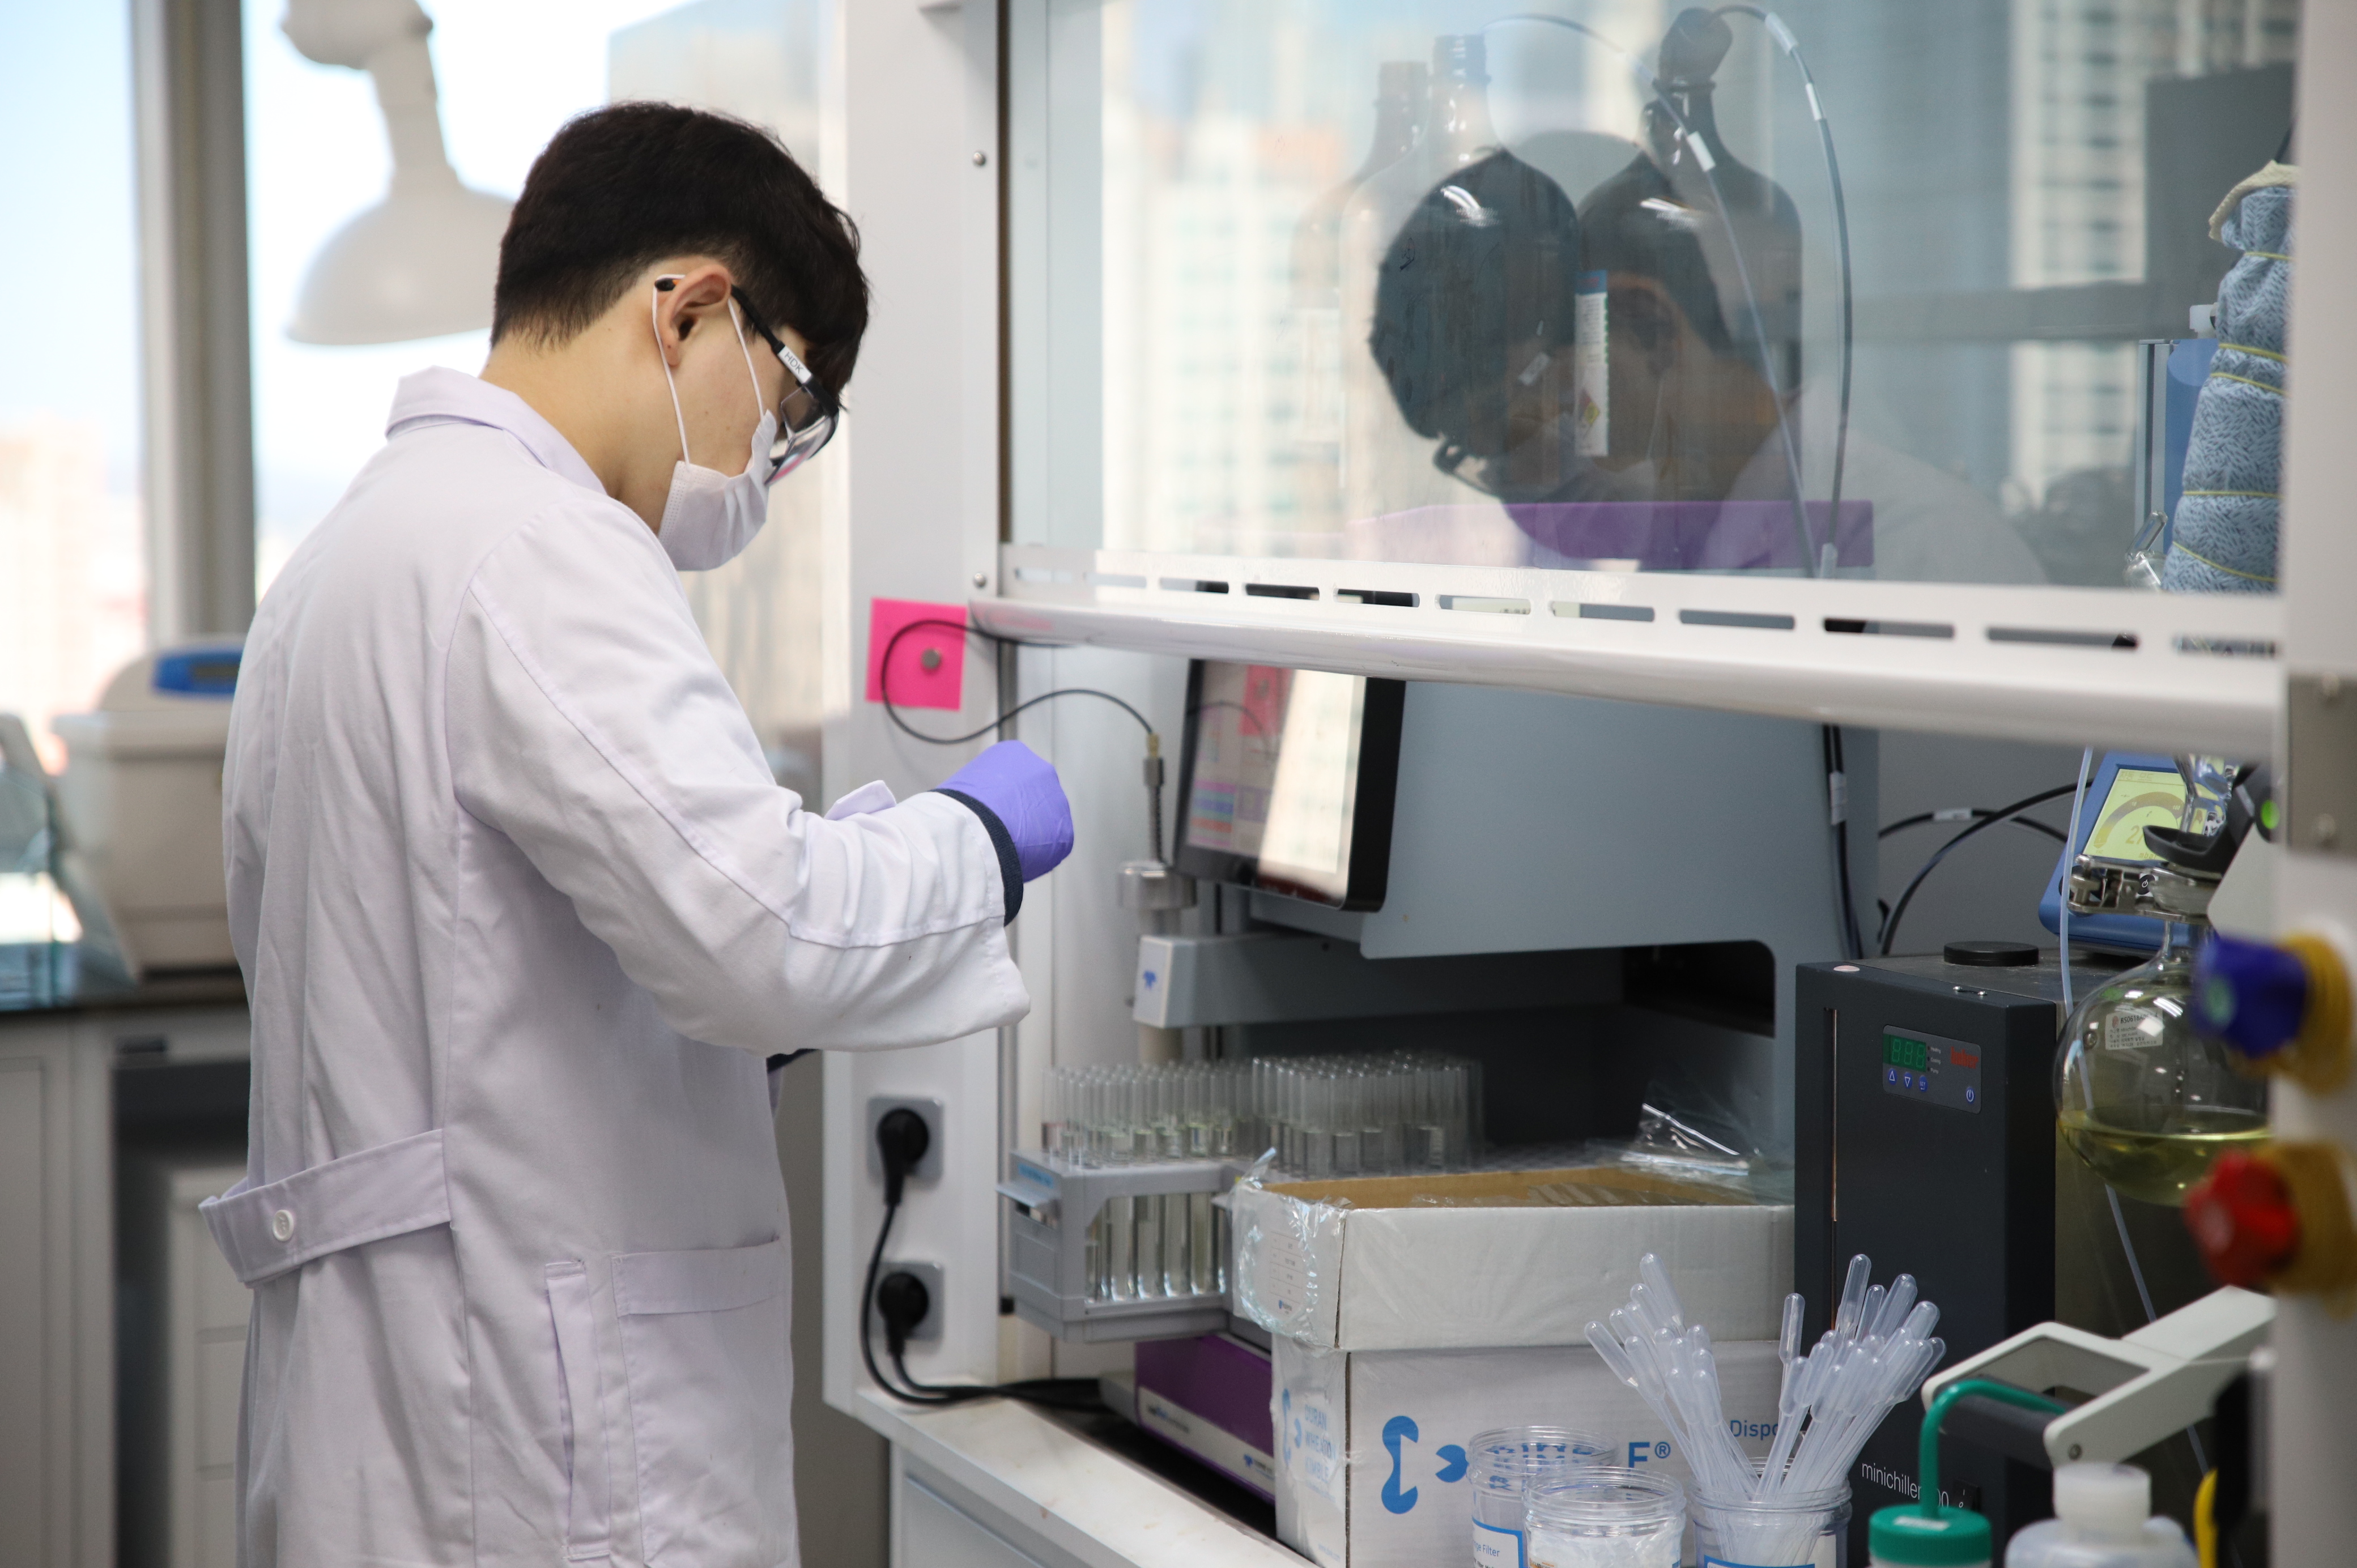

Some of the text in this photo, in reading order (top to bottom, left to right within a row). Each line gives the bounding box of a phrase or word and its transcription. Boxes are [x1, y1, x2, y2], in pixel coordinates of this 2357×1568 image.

[784, 351, 803, 374] HDK
[1862, 1463, 1922, 1500] minichiller
[1483, 1544, 1500, 1557] Filter
